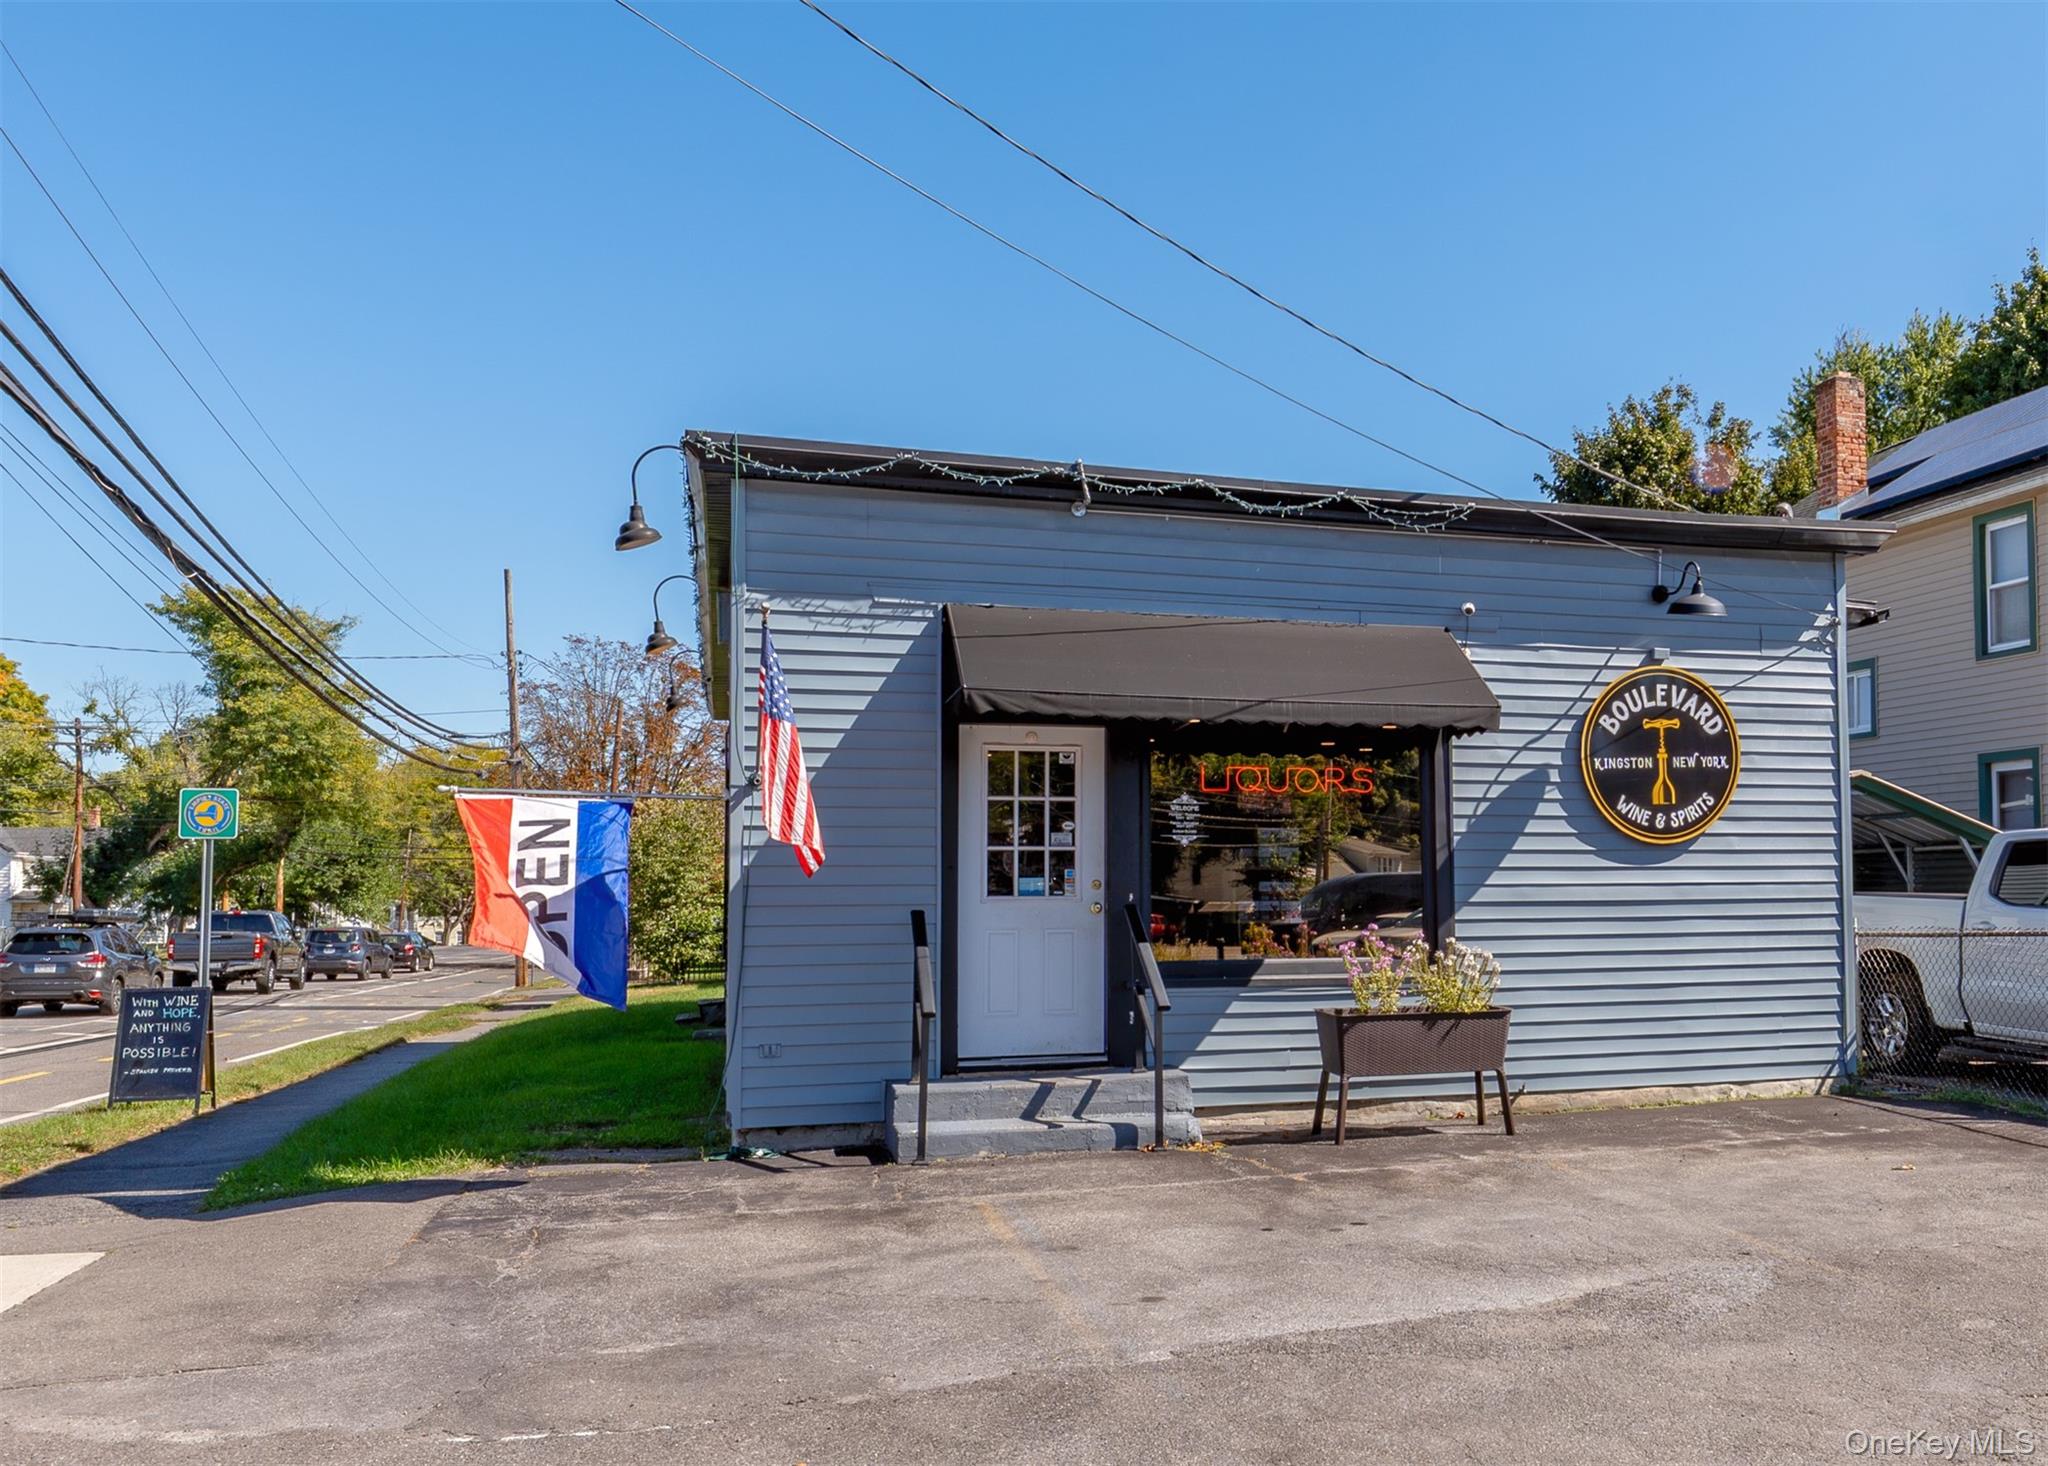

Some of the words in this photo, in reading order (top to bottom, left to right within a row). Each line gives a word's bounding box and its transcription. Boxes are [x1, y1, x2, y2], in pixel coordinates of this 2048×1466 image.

[1599, 684, 1723, 735] BOULEVARD
[1594, 757, 1653, 771] KINGSTON
[1673, 752, 1699, 768] NEW
[1701, 755, 1729, 769] YORK
[1200, 763, 1374, 793] LIQUORS
[1616, 794, 1652, 826] WINE
[1655, 812, 1666, 829] &
[1670, 792, 1714, 828] SPIRITS
[132, 996, 159, 1007] WITH
[163, 994, 199, 1007] WINE
[133, 1009, 154, 1018] AND
[129, 1022, 192, 1034] ANYTHING
[153, 1035, 165, 1044] IS
[122, 1046, 197, 1059] POSSIBLE!
